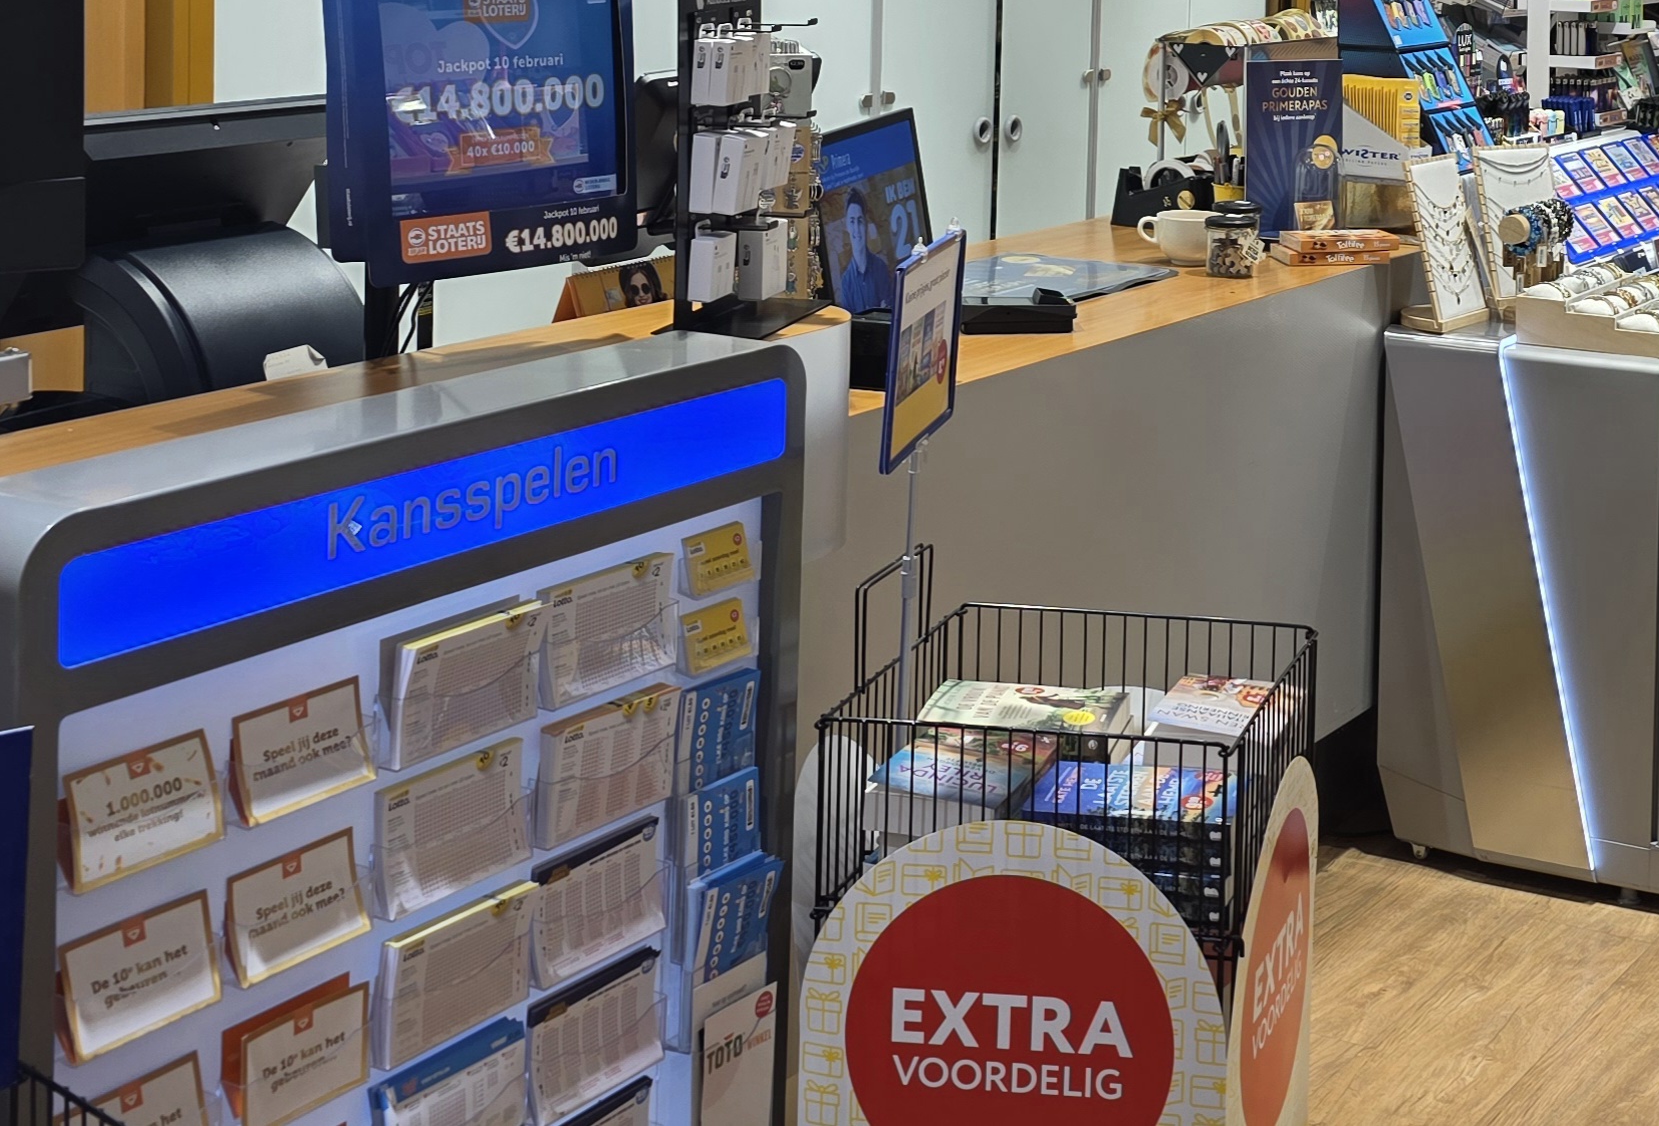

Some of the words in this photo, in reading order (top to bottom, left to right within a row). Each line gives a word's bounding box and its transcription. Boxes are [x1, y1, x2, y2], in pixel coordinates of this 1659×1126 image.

[482, 4, 527, 17] LOTERIJ
[437, 58, 491, 74] Jackpot
[494, 56, 510, 70] 10
[513, 53, 564, 70] februari
[388, 73, 606, 124] €14.800.000
[1262, 99, 1328, 113] PRIMERAPAS
[1272, 86, 1318, 98] GOUDEN
[466, 145, 489, 158] 40x
[491, 140, 536, 158] €10.000
[830, 152, 852, 168] Primera
[884, 184, 896, 205] IK
[896, 177, 916, 202] BEN
[428, 220, 486, 240] STAATS
[543, 208, 570, 221] Jackpot
[888, 199, 921, 259] 21
[428, 236, 487, 255] LOTERIJ
[505, 216, 618, 254] €14.800.000
[559, 252, 573, 262] Mis
[326, 442, 619, 561] Kansspelen
[252, 759, 297, 782] maand
[298, 747, 322, 765] ook
[322, 735, 352, 757] mee?
[262, 743, 296, 765] Speel
[297, 737, 311, 754] jij
[311, 728, 340, 744] deze
[105, 777, 183, 818] 1.000.000
[255, 896, 289, 921] Speel
[290, 890, 304, 908] jij
[305, 879, 333, 899] deze
[290, 903, 314, 921] ook
[315, 887, 346, 911] mee?
[90, 976, 110, 994] De
[135, 955, 162, 975] kan
[163, 943, 188, 963] het
[1253, 892, 1304, 1023] EXTRA
[891, 987, 1133, 1058] EXTRA
[261, 1063, 279, 1081] De
[300, 1042, 324, 1059] kan
[324, 1031, 346, 1049] het
[706, 1033, 743, 1075] TOTO
[892, 1054, 1123, 1100] VOORDELIG
